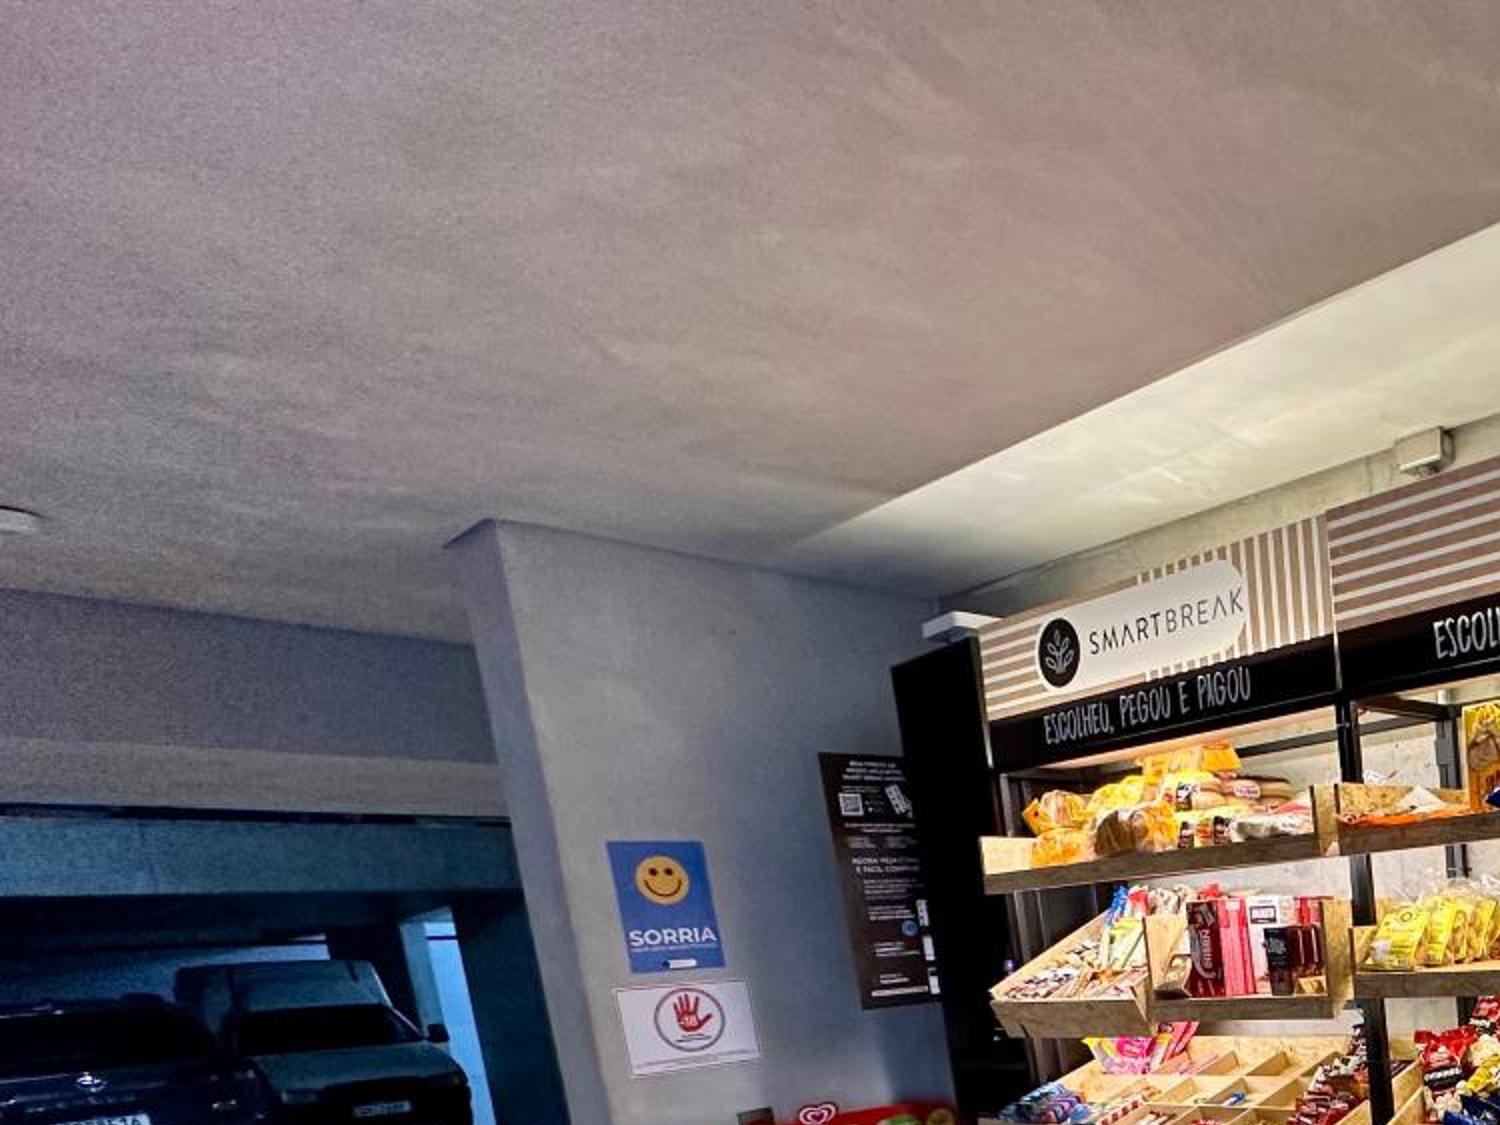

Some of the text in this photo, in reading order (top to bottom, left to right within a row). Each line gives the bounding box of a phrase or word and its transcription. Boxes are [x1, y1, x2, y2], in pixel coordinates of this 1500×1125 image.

[1089, 587, 1244, 655] SMARTBREAK
[1044, 666, 1250, 745] ESCOLHEU, PEGOU E PAGOU
[628, 927, 717, 946] SORRIA
